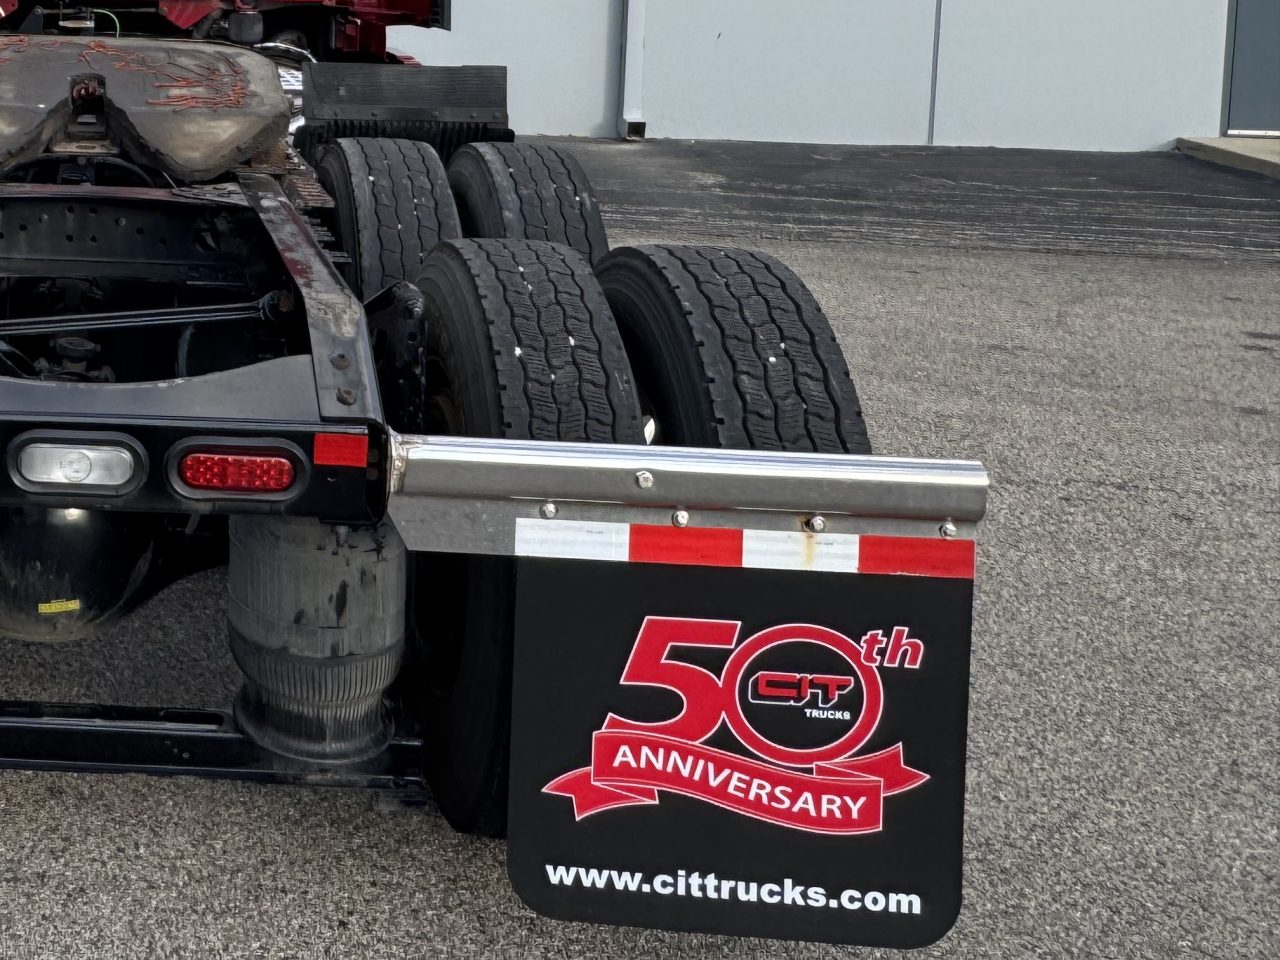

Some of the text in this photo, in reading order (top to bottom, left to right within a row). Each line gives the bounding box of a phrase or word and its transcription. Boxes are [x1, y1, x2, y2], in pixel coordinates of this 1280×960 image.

[748, 671, 855, 708] CIT
[804, 708, 852, 721] TRUCKS
[612, 744, 868, 819] ANNIVERSARY
[545, 863, 923, 915] www.cittrucks.com
